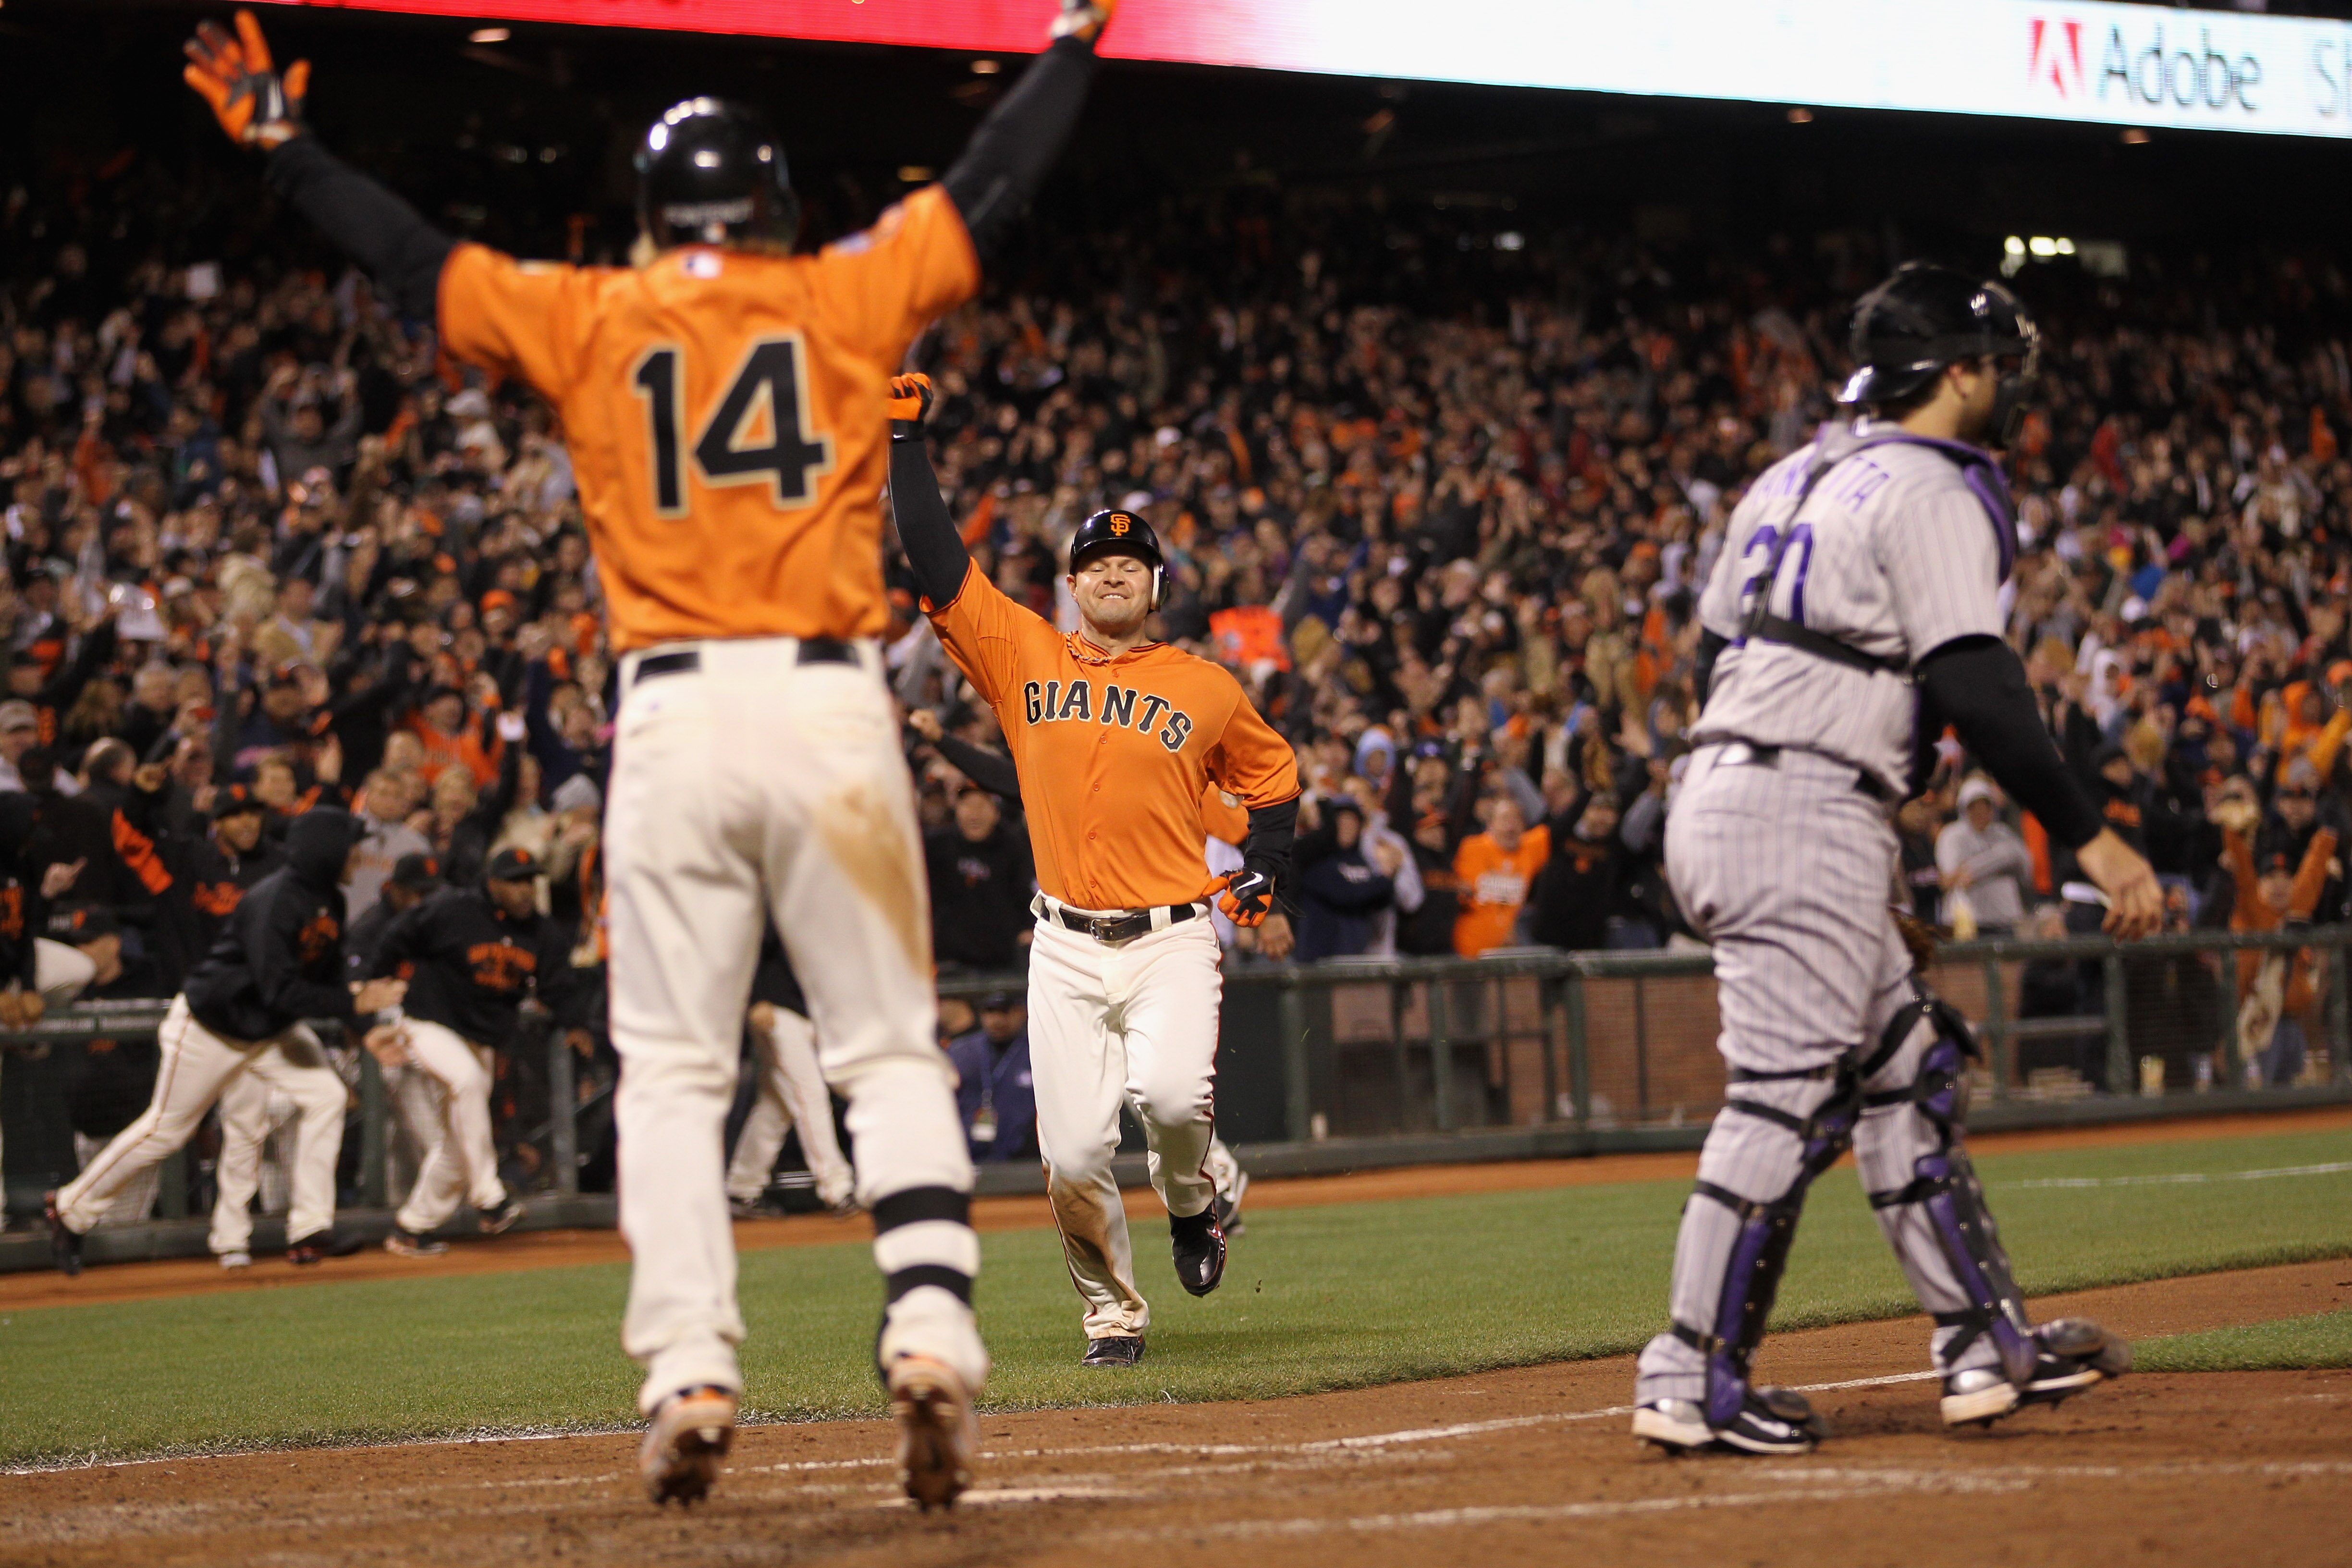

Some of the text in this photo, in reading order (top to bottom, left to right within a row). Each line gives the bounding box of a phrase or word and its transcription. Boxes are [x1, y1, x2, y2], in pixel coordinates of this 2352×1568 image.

[2097, 22, 2261, 110] Adobe
[630, 332, 835, 518] 14
[1110, 514, 1131, 536] SF
[1738, 522, 1815, 640] 20
[1023, 679, 1193, 753] GIANTS
